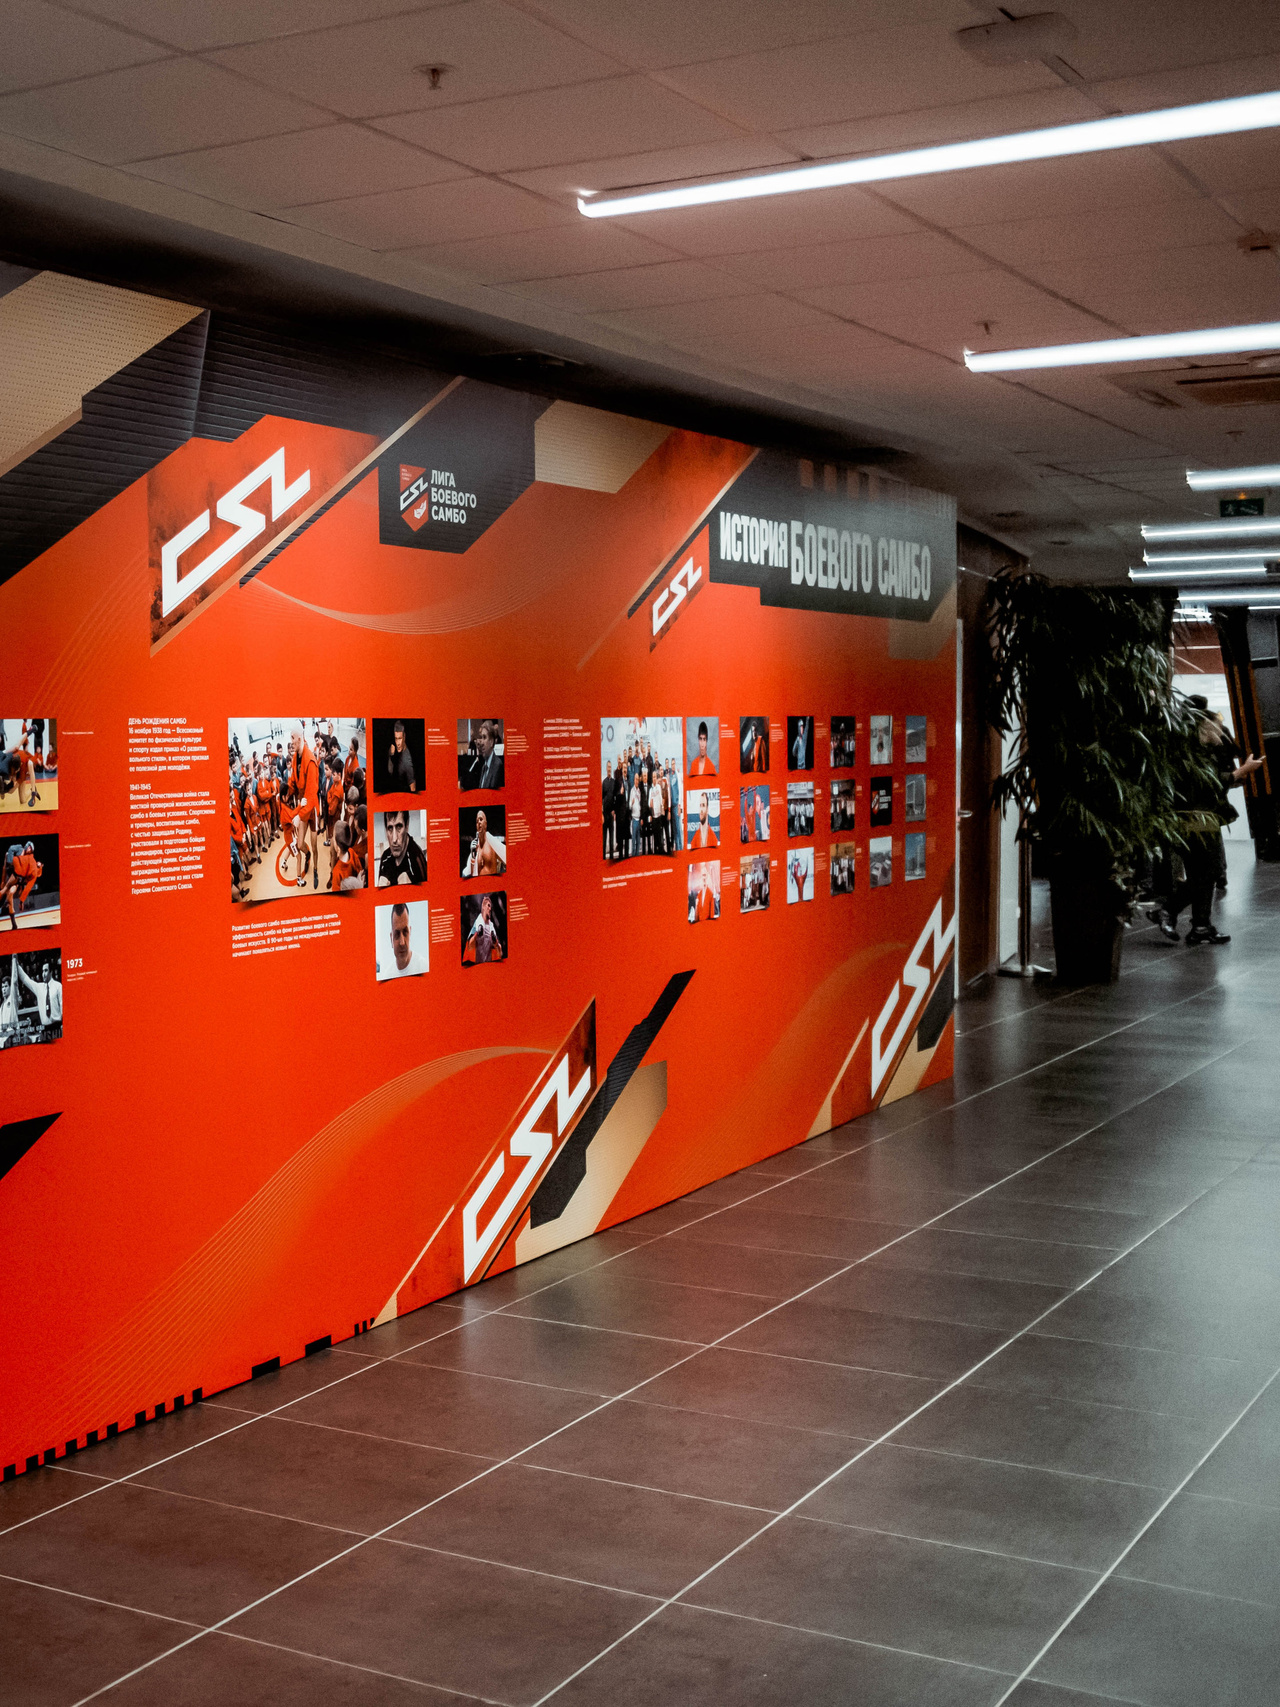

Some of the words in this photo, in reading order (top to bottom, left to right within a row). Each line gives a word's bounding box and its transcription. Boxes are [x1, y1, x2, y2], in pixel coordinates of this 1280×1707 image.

[430, 469, 456, 488] ЛИГА
[431, 487, 477, 509] БОЕВОГО
[431, 505, 467, 524] САМБО
[720, 511, 788, 568] ИСТОРИЯ
[790, 520, 873, 594] БОЕВОГО
[878, 537, 932, 601] САМБО
[66, 958, 83, 969] 1973
